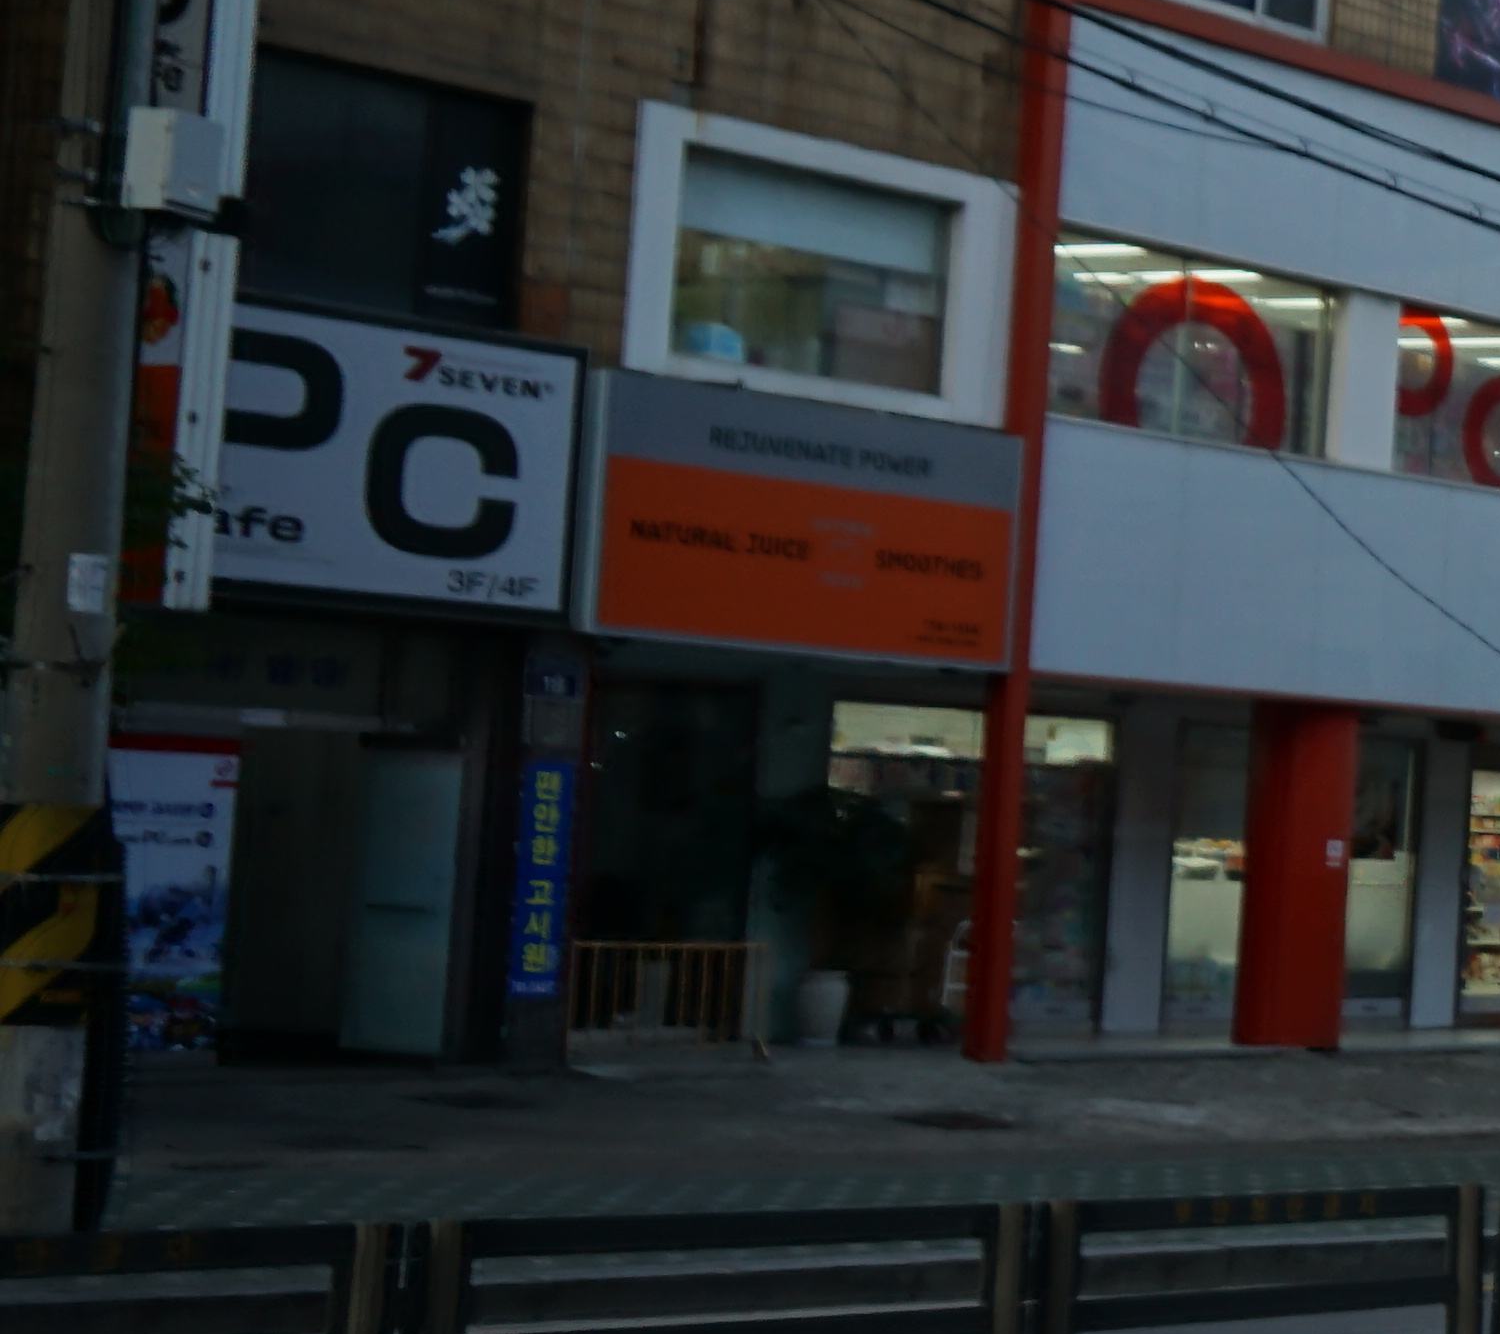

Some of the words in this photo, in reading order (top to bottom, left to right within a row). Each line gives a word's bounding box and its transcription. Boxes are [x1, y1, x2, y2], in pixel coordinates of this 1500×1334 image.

[709, 425, 853, 466] REJUVENATE
[859, 450, 933, 476] POWER
[630, 519, 736, 552] NATURAL
[745, 533, 810, 560] JUICE
